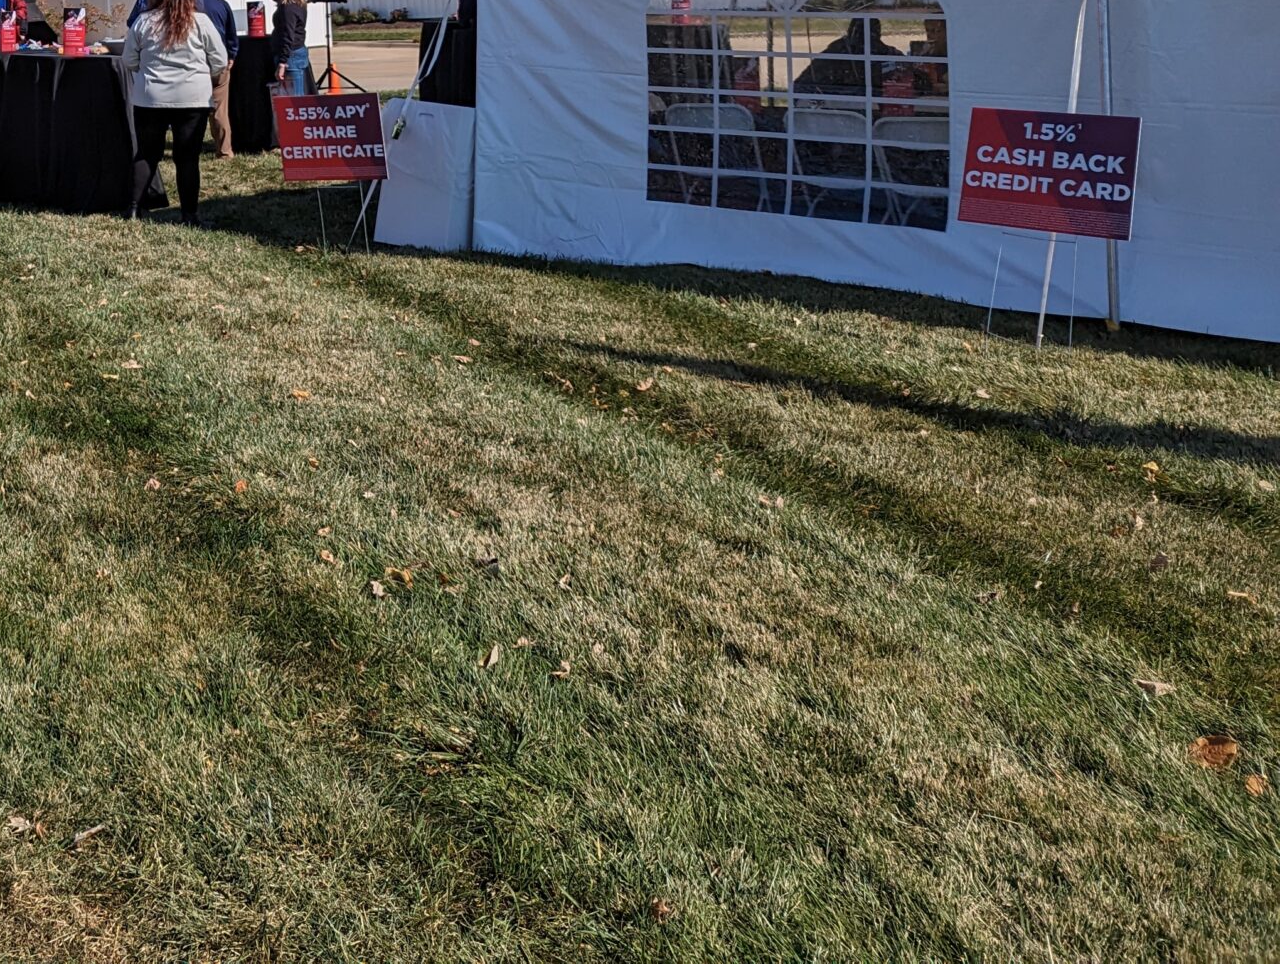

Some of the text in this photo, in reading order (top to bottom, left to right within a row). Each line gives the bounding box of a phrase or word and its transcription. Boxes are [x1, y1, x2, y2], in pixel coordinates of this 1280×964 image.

[285, 106, 331, 121] 3.55%
[303, 125, 357, 140] SHARE
[283, 144, 384, 159] CERTIFICATE
[976, 145, 1127, 174] CASH BACK
[965, 170, 1131, 201] CREDIT CARD
